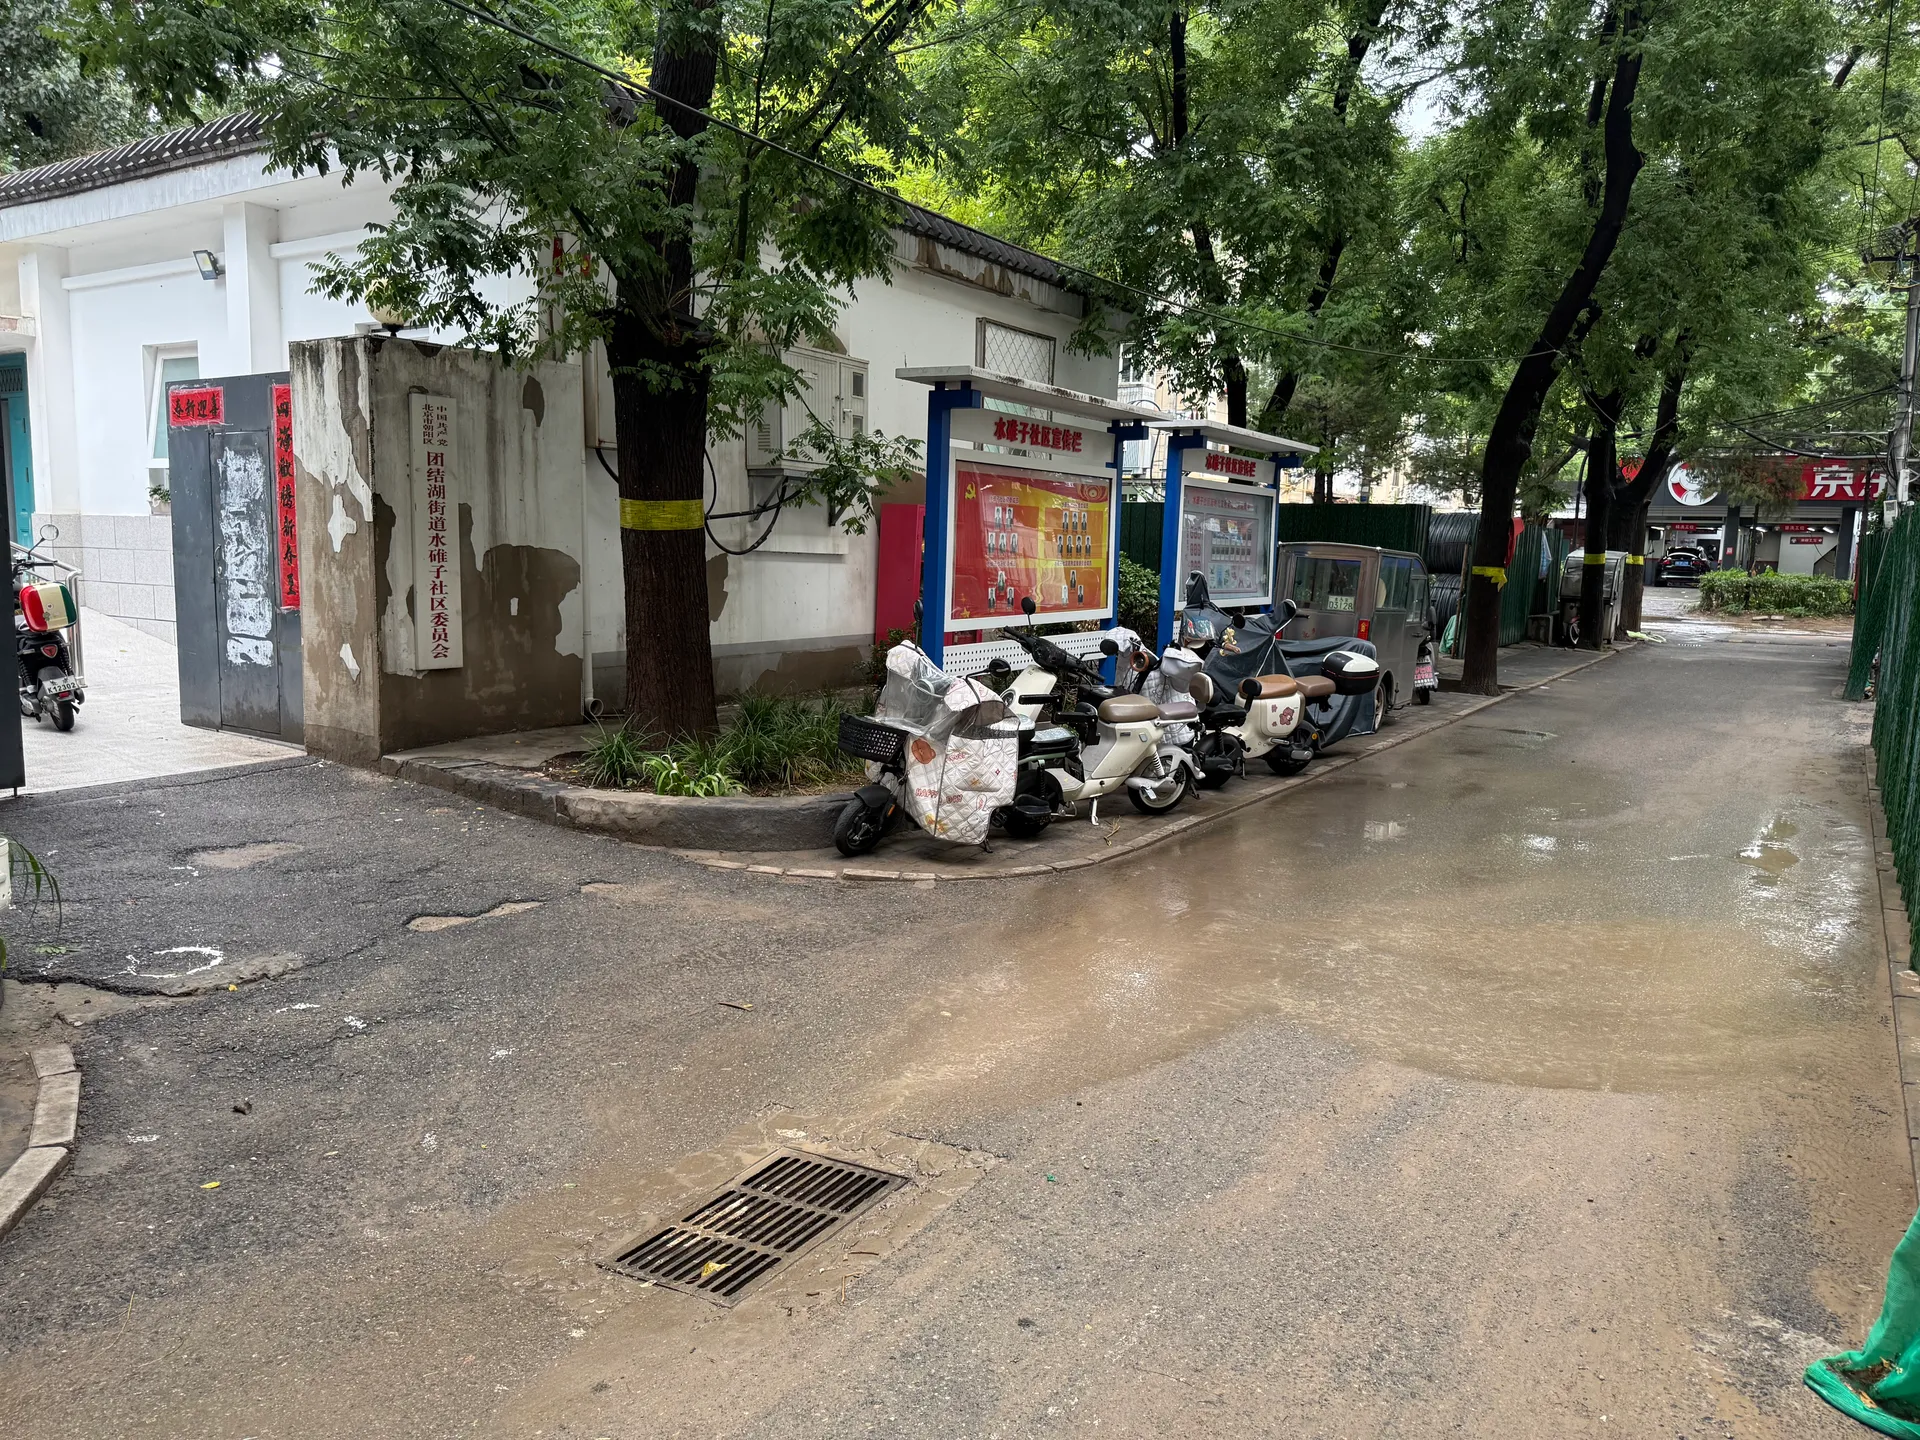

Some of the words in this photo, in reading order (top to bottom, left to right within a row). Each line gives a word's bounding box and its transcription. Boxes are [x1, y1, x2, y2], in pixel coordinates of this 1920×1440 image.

[422, 403, 434, 445] 北京市朝阳区
[436, 404, 448, 446] 中国共产党
[993, 416, 1082, 452] 水碓子社区宣传栏
[1205, 453, 1256, 477] 水碓子社区宣传栏
[426, 451, 450, 659] 团结湖街道水碓子社区委员会
[47, 682, 76, 694] K12302
